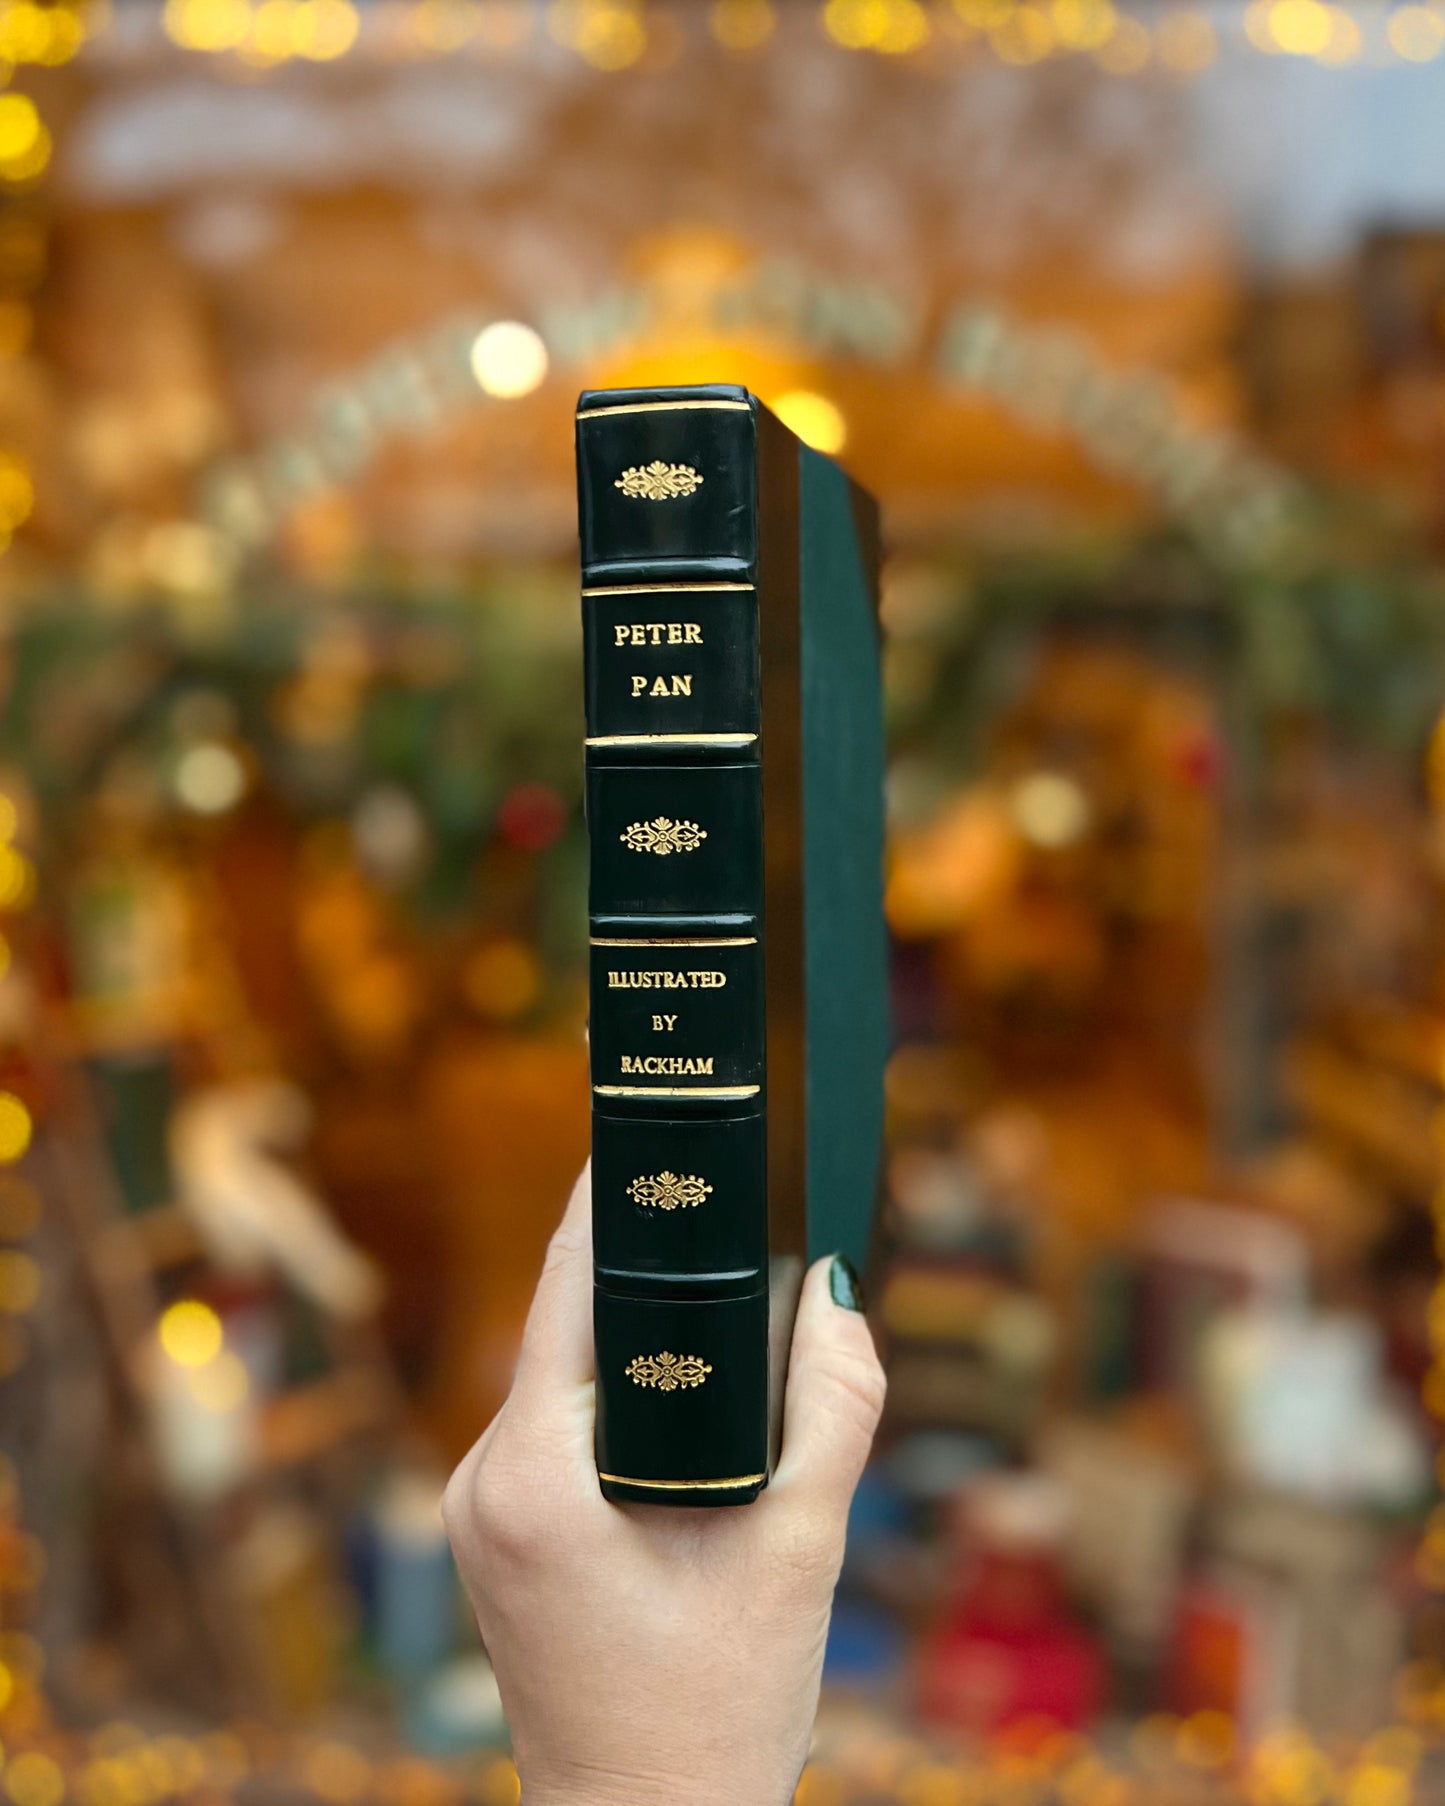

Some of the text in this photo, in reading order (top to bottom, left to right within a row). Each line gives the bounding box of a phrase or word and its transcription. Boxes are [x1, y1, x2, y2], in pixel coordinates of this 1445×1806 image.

[614, 623, 704, 646] PETER
[631, 674, 693, 697] PAN
[607, 971, 727, 989] ILLUSTRATED
[651, 1014, 678, 1032] BY
[620, 1055, 714, 1076] RACKHAM
